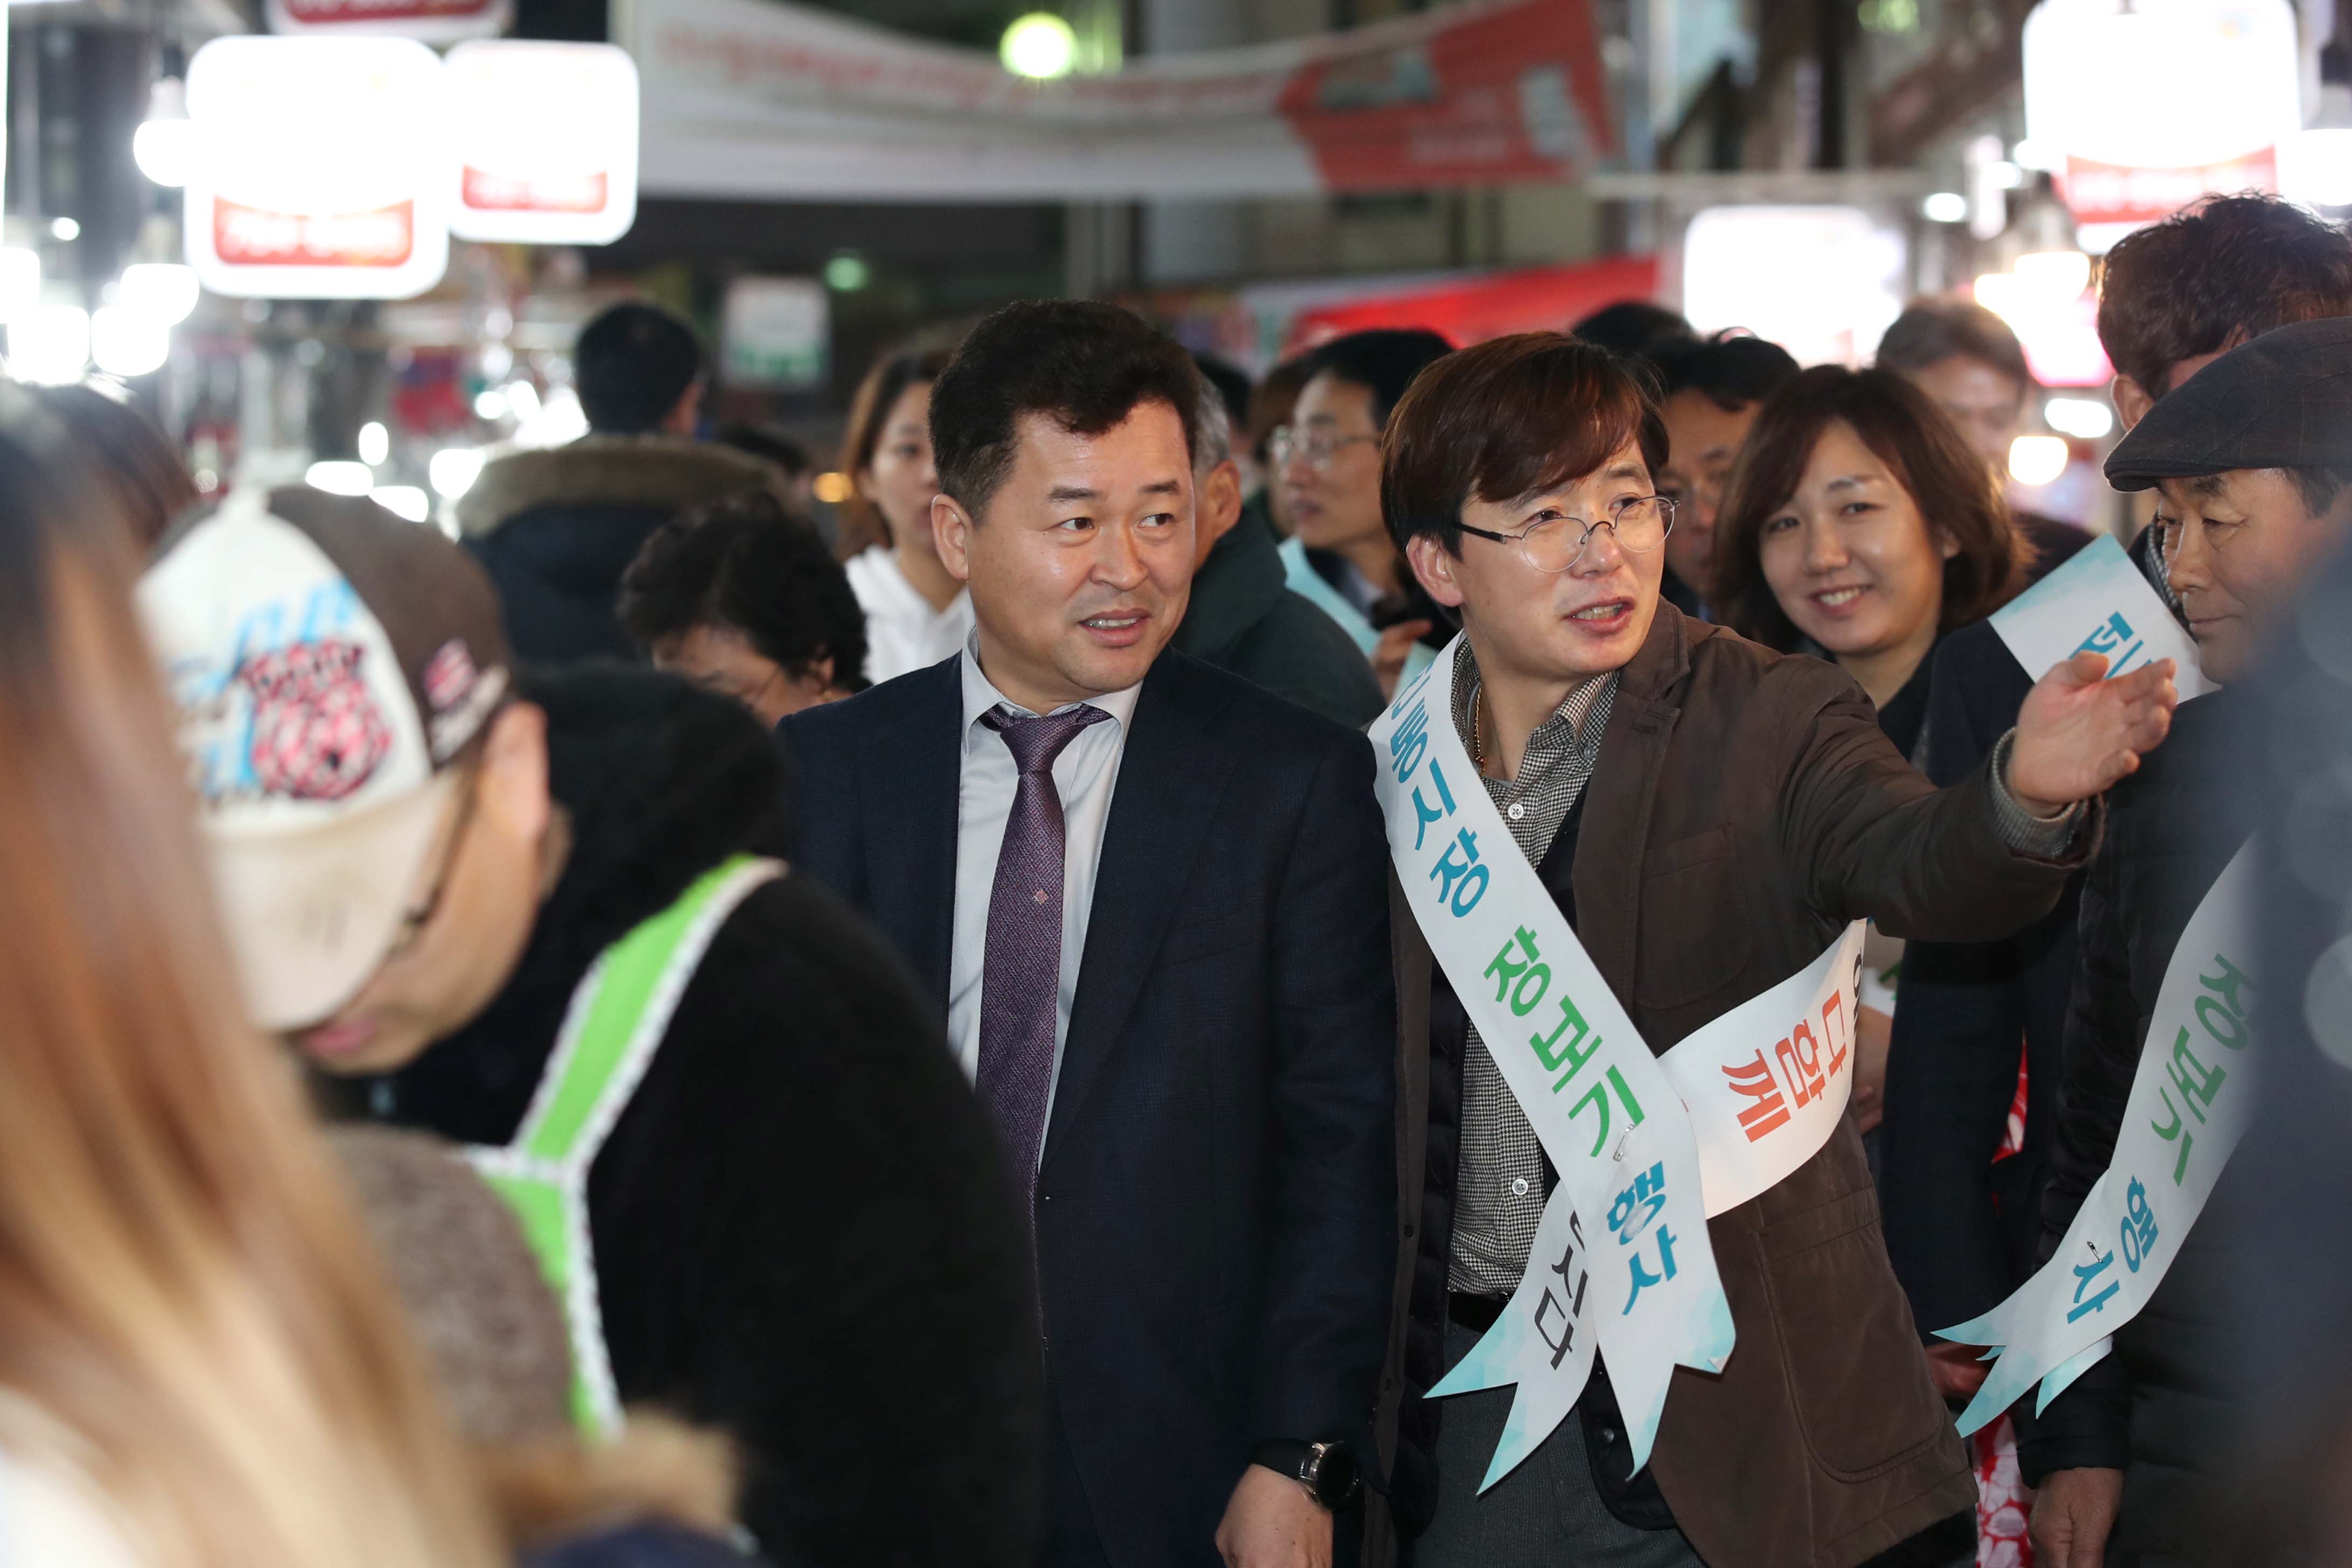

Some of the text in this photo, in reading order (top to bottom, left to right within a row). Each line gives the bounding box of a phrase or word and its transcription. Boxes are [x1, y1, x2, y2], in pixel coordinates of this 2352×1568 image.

[1483, 925, 1646, 1158] 장보기
[1607, 1160, 1678, 1315] 행사
[1721, 989, 1847, 1143] 다함께
[2067, 953, 2258, 1325] 장보기 행사
[1534, 1210, 1588, 1370] 시다
